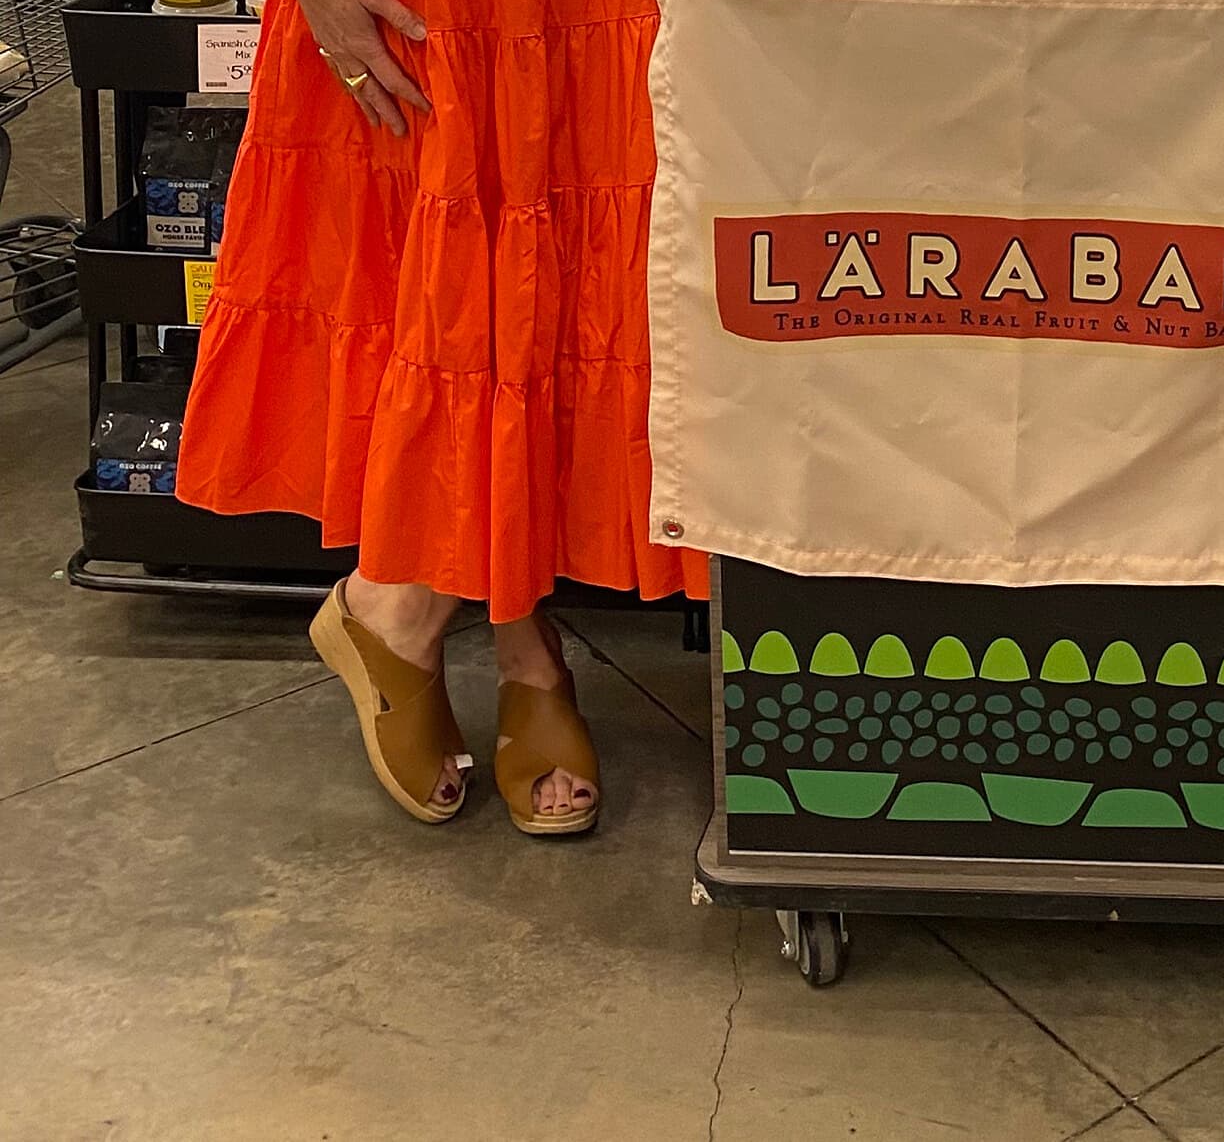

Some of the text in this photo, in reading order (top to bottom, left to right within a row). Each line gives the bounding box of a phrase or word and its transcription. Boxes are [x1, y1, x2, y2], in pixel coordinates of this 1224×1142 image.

[206, 40, 242, 49] Spanish
[235, 51, 250, 59] Mix
[156, 224, 181, 233] OZO
[774, 312, 820, 332] THE
[834, 308, 946, 327] ORIGINAL
[960, 309, 1021, 329] REAL
[1035, 311, 1100, 331] FRUIT
[1114, 315, 1129, 333] &
[1145, 317, 1191, 339] NUT
